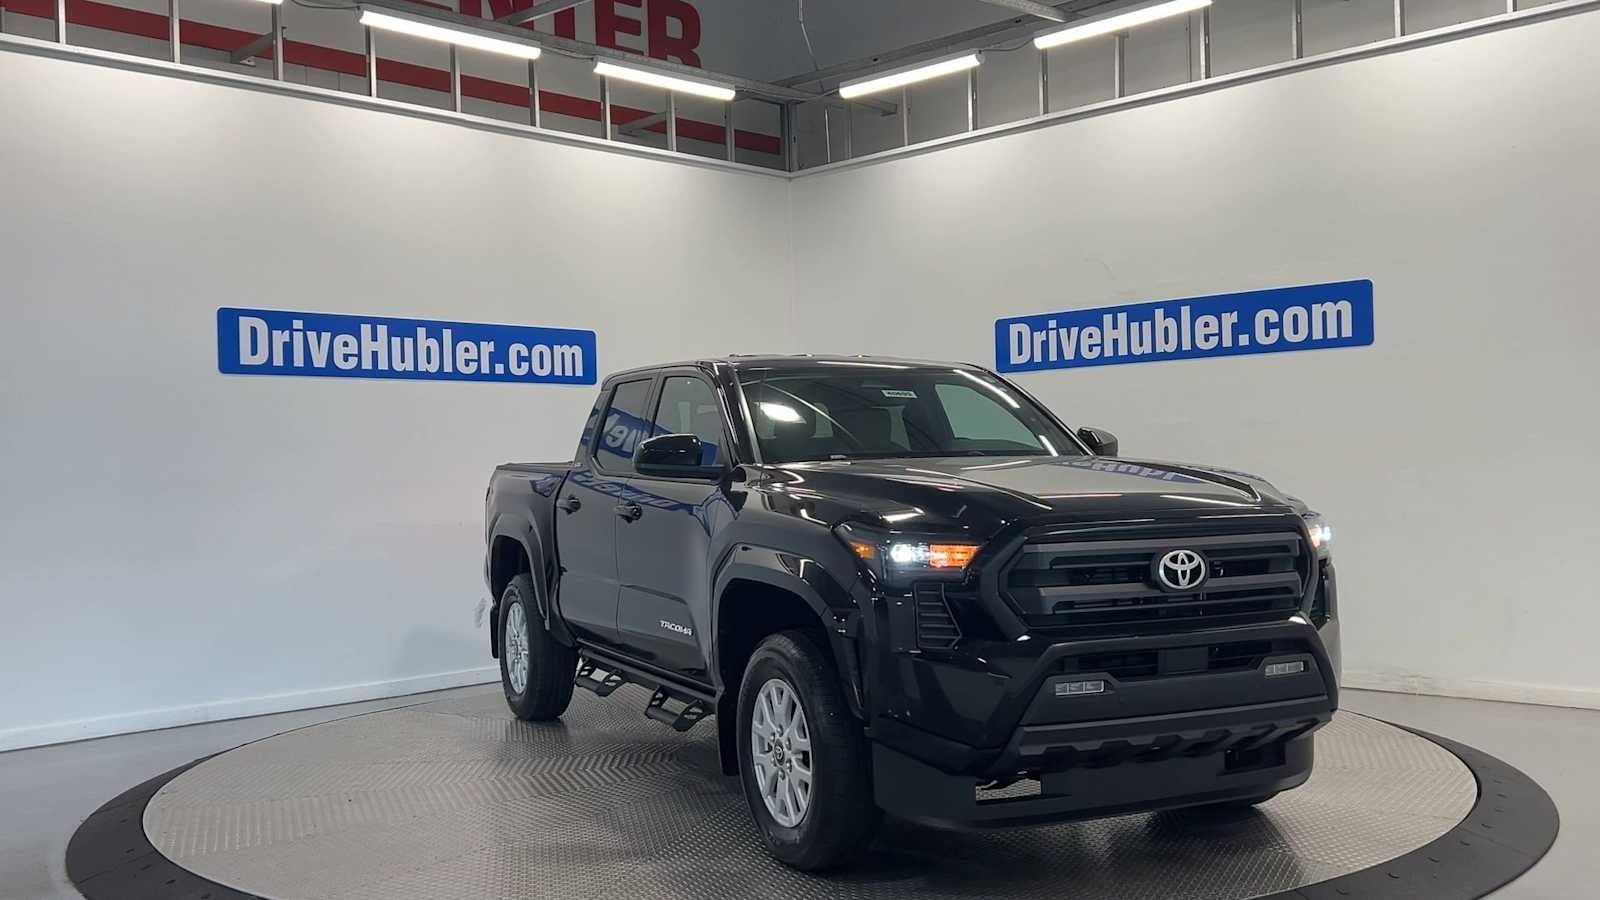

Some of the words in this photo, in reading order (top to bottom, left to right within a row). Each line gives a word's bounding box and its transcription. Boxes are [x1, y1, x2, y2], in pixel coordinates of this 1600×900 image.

[238, 315, 584, 377] DriveHubler.com
[1008, 299, 1353, 366] DriveHubler.com
[659, 619, 693, 636] TACOMA
